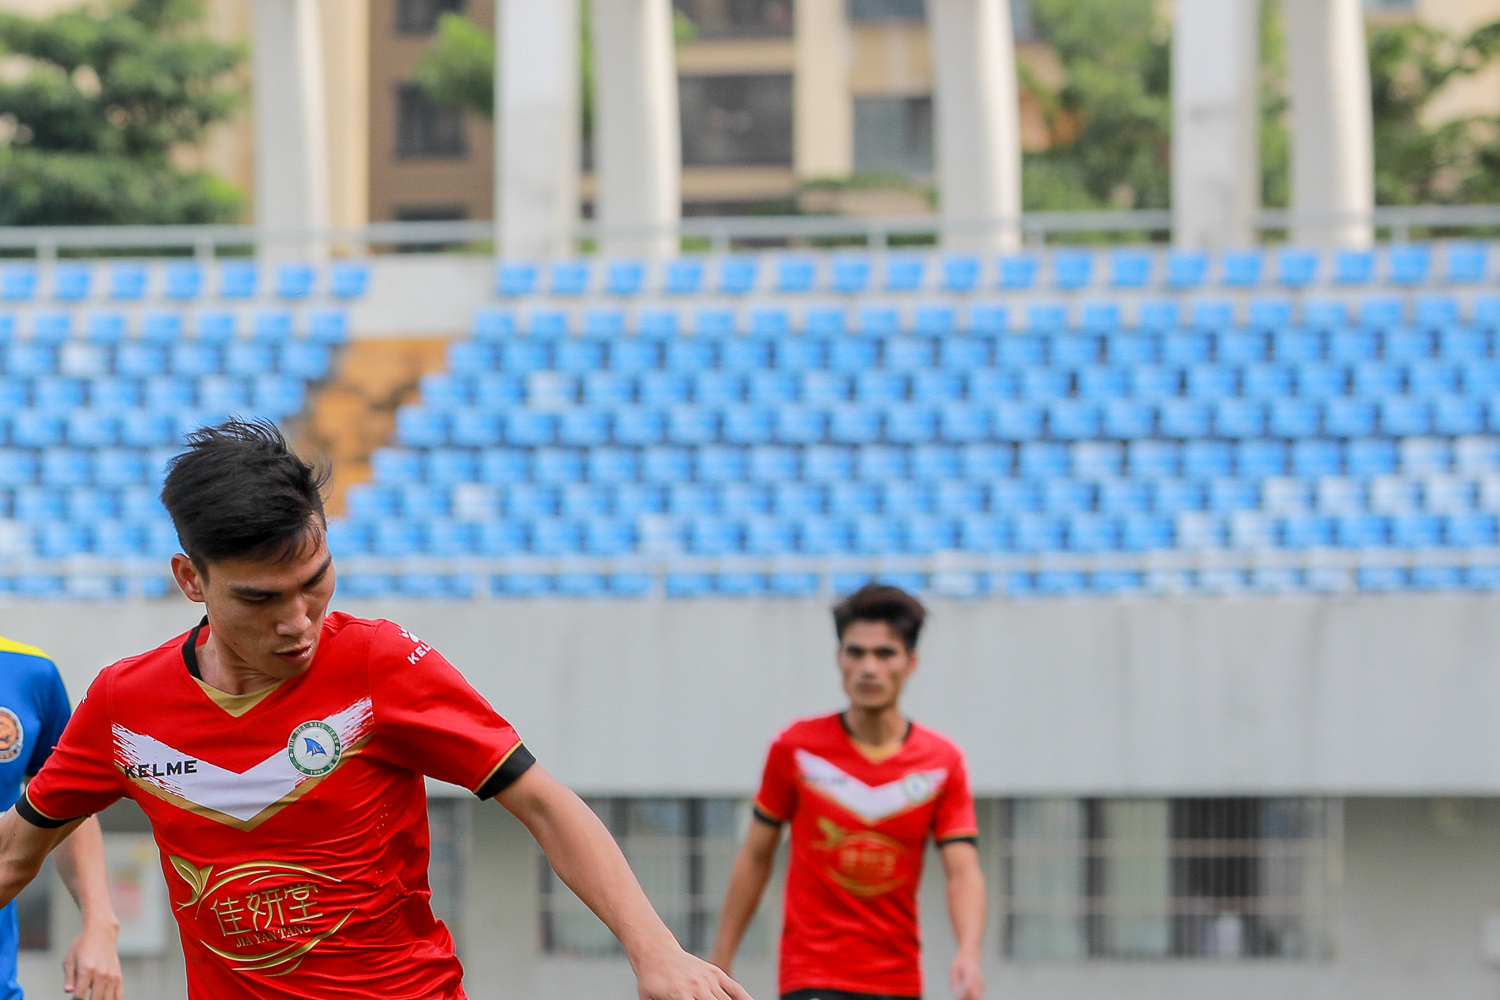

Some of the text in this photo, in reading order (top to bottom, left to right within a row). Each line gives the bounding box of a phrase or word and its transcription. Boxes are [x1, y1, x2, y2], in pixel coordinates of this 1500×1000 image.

[407, 643, 432, 665] KEL
[124, 760, 198, 778] KELME
[236, 925, 311, 948] JIA YAN TANG
